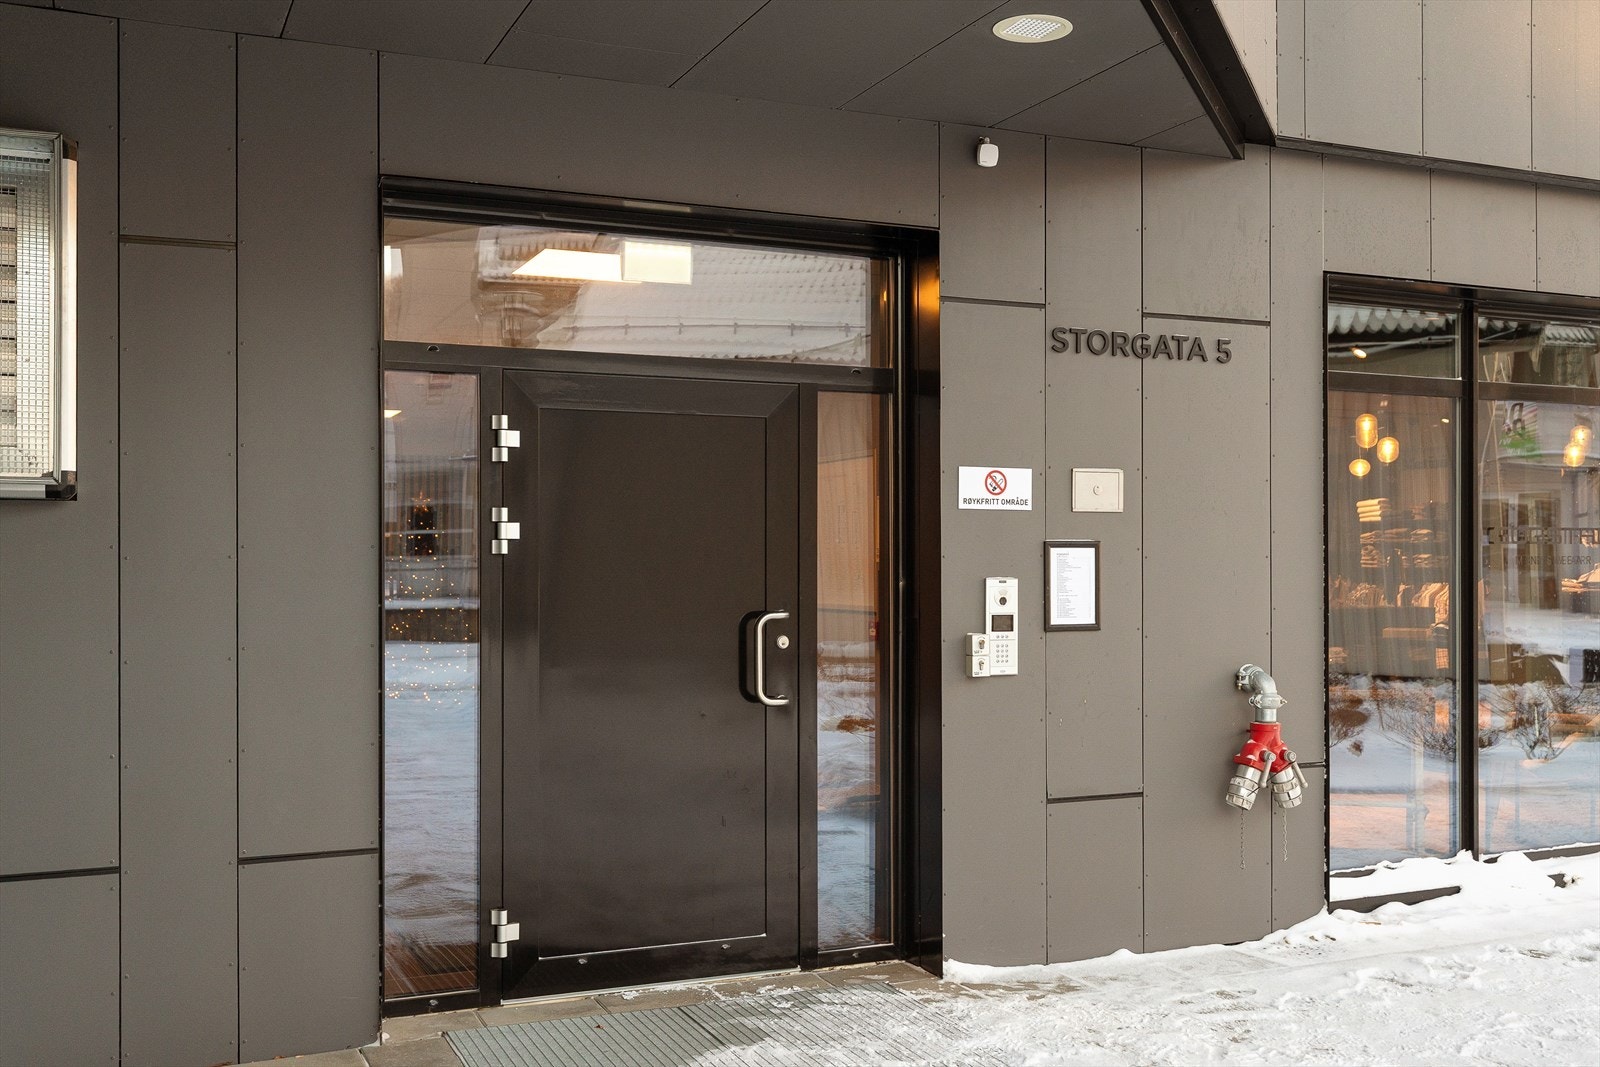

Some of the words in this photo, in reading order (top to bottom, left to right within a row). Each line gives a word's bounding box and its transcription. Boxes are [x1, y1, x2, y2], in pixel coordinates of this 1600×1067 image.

[1051, 327, 1208, 362] STORGATA
[1216, 338, 1232, 364] 5
[1001, 497, 1028, 506] OMRÅDE
